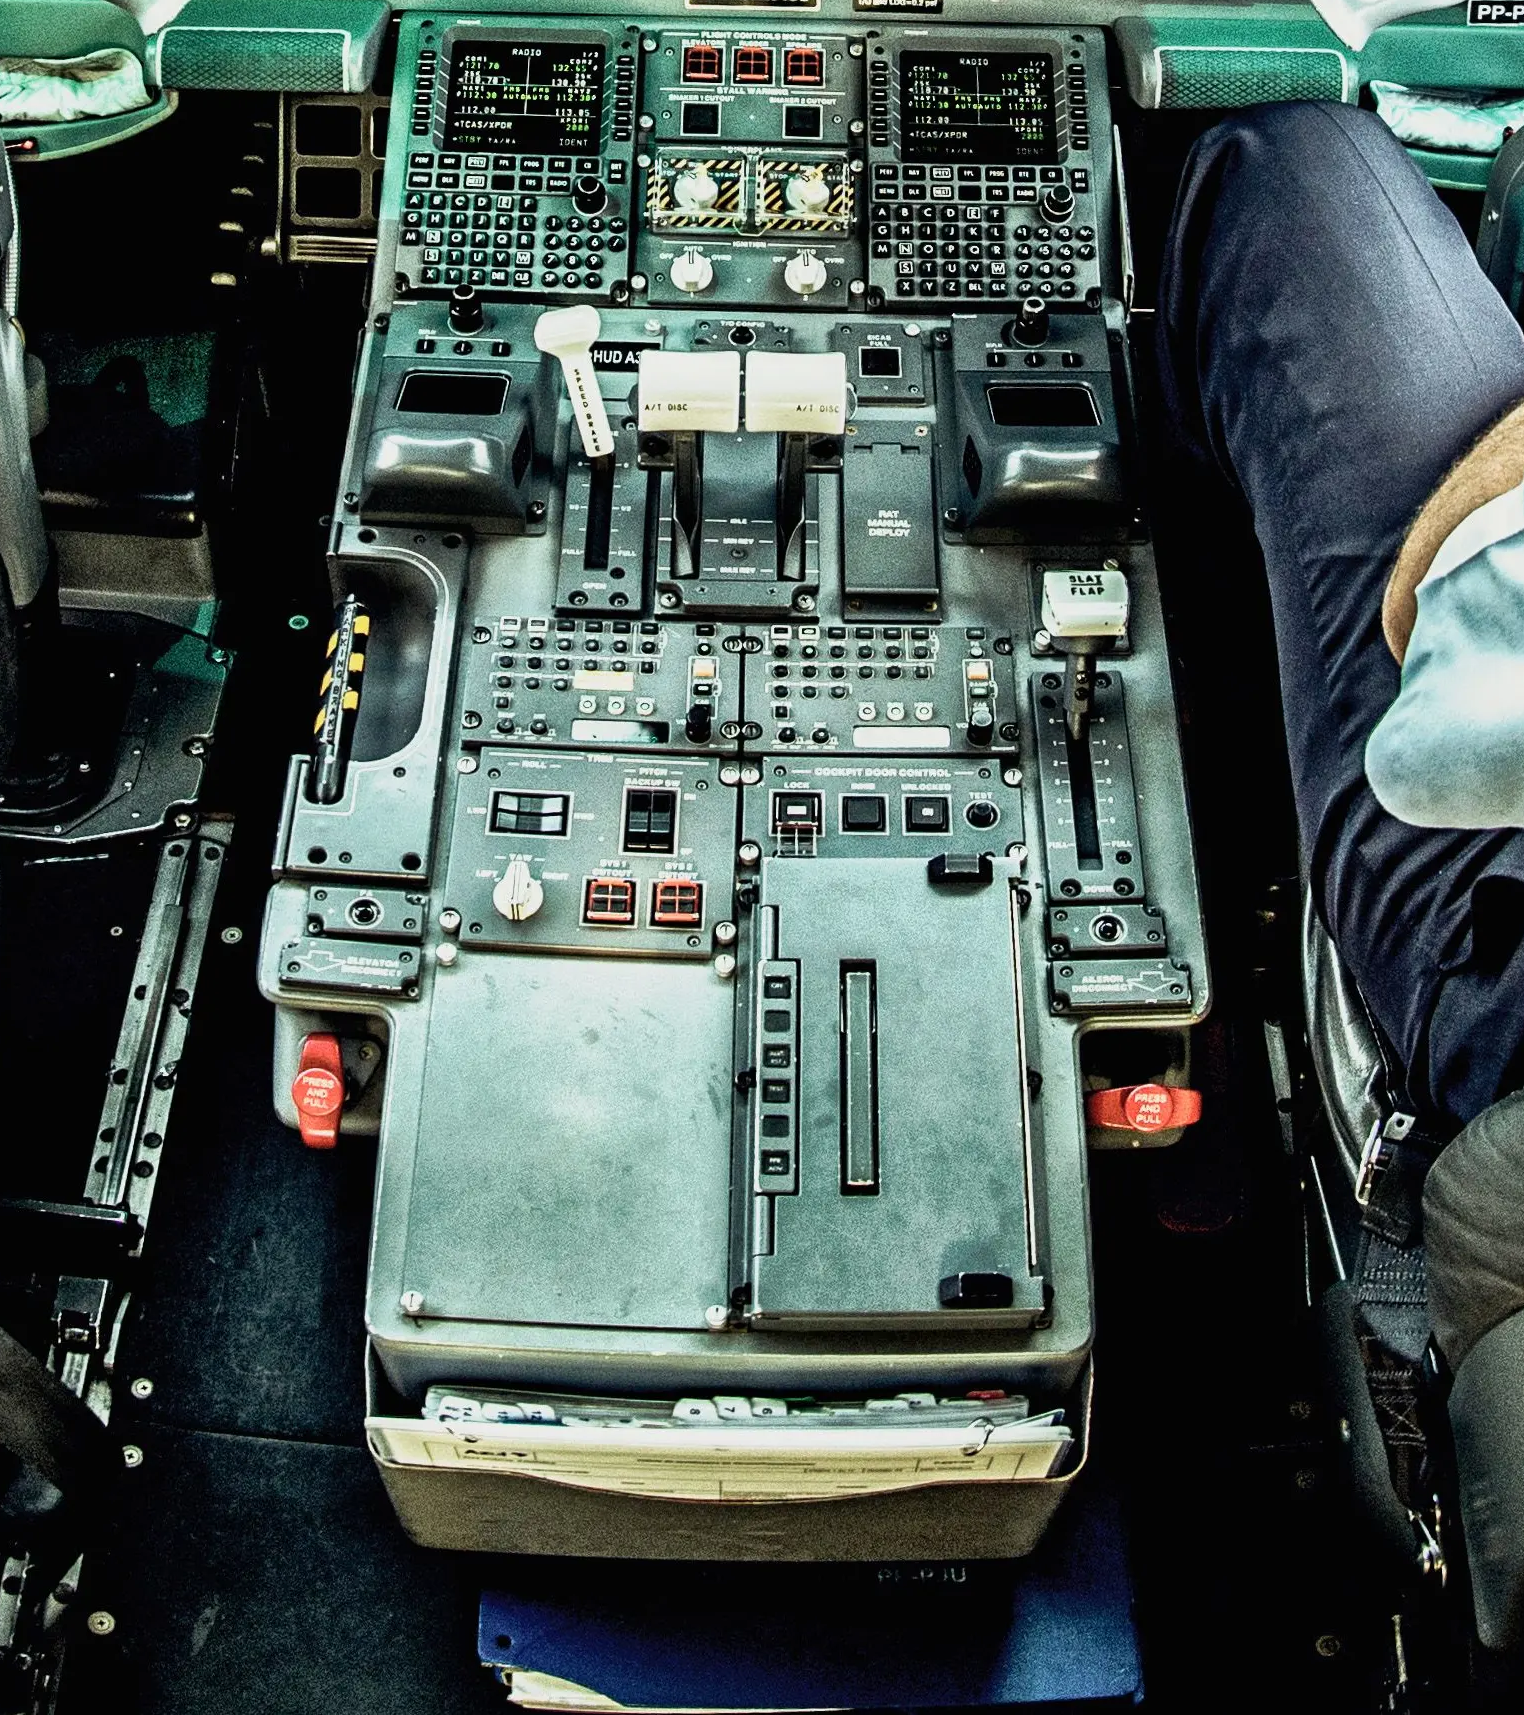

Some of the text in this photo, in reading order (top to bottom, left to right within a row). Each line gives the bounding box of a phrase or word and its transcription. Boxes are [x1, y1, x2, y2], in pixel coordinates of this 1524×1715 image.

[512, 48, 542, 56] RADIO
[959, 58, 989, 66] RADIO
[559, 138, 589, 146] IDENT
[593, 351, 622, 364] HUD
[574, 369, 600, 452] SPEED BRAKE
[645, 403, 688, 412] A/T DISC
[878, 510, 900, 518] RAT
[867, 519, 912, 528] MANUAL
[869, 528, 910, 537] DEPLOY
[1069, 575, 1103, 585] SLAT
[1070, 587, 1105, 596] FLAP
[326, 607, 353, 741] PARKING BRAKE
[814, 768, 952, 777] COCKPIT DOOR CONTROL
[302, 1075, 335, 1089] PRESS
[306, 1088, 328, 1098] AND
[303, 1097, 328, 1109] PULL
[1134, 1093, 1167, 1104] PRESS
[1138, 1104, 1161, 1114] AND
[1135, 1114, 1162, 1125] PULL
